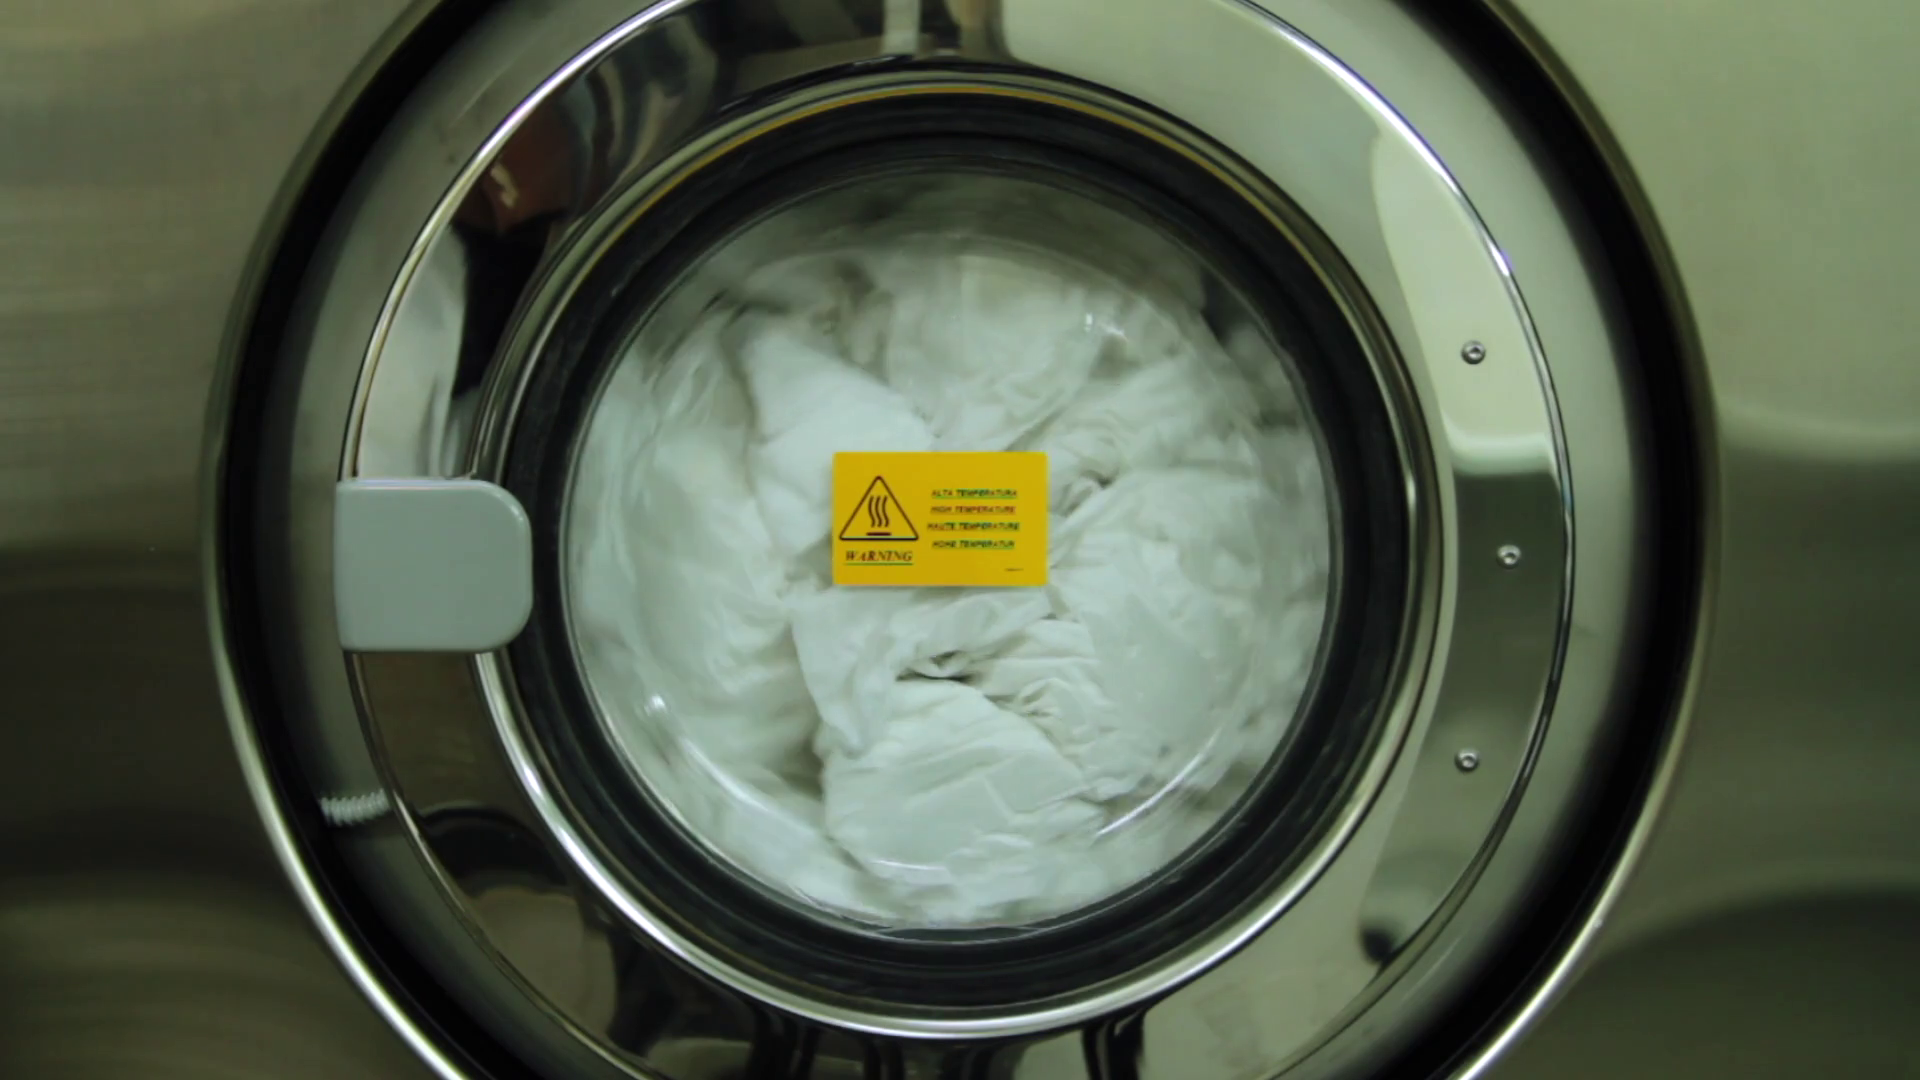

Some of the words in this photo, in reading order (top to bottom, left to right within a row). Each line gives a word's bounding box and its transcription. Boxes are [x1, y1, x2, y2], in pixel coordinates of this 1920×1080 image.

[932, 489, 953, 498] ALTA
[956, 489, 1017, 498] TEMPERATURA
[931, 506, 952, 514] HIGH
[955, 506, 1016, 514] TEMPERATURE
[927, 522, 956, 531] HAUTE
[959, 522, 1020, 531] TEMPERATURE
[960, 540, 1015, 549] TEMPERATUR
[846, 550, 913, 561] WARNING
